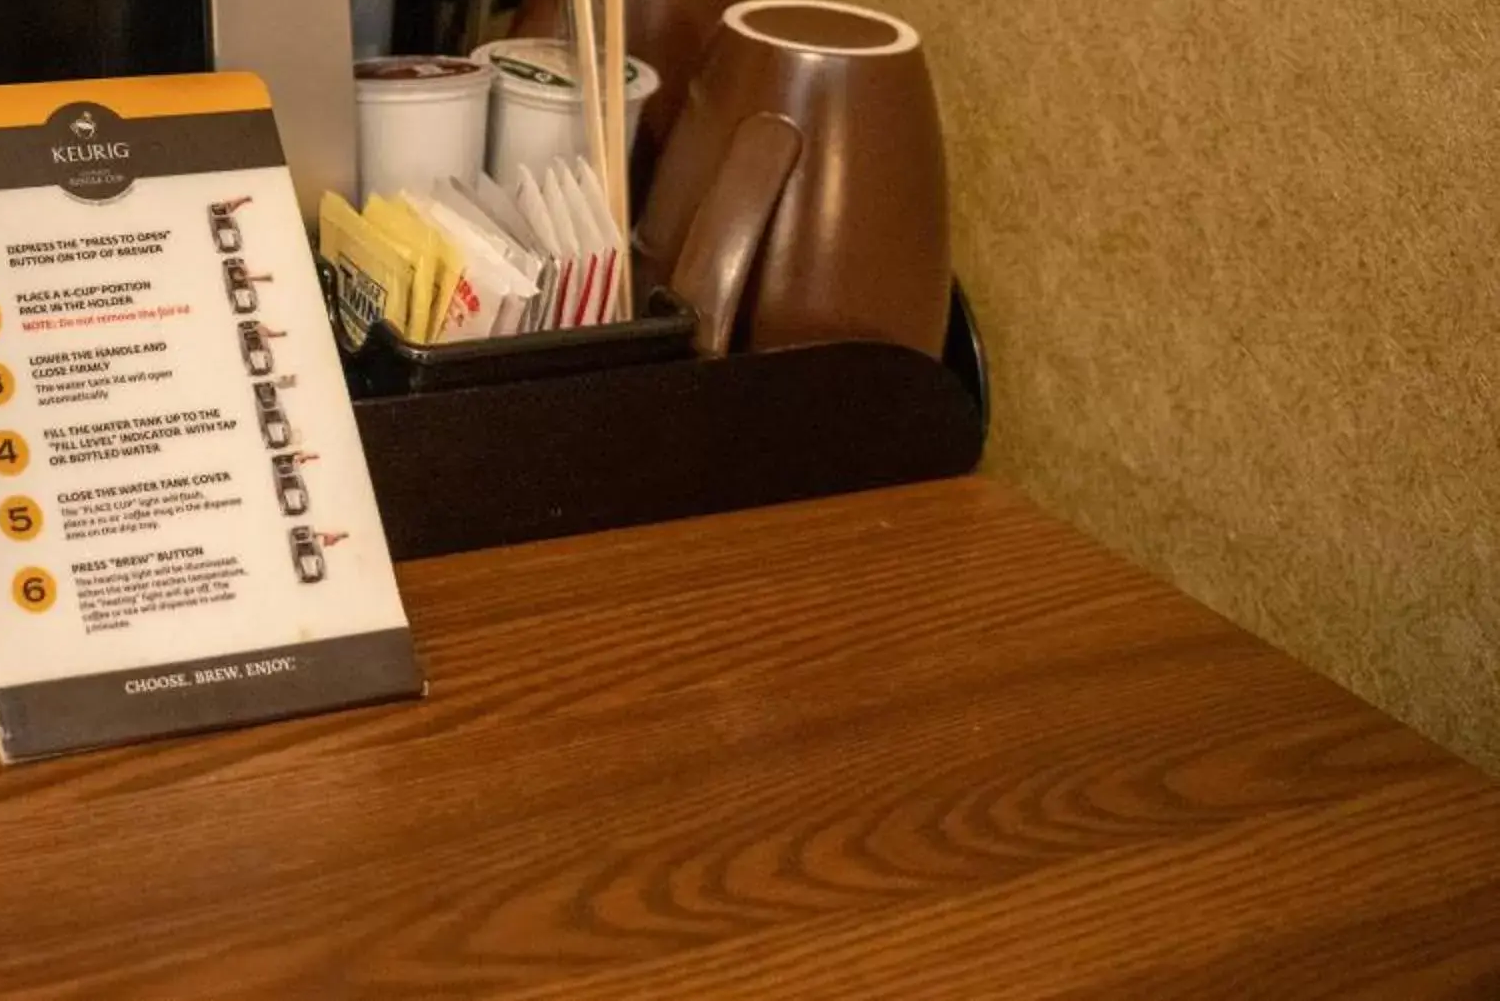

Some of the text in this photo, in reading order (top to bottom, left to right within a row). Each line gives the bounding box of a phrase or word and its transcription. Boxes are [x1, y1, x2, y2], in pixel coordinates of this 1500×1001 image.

[51, 142, 130, 163] KEURIG
[7, 241, 55, 255] DEPRESS
[57, 239, 77, 250] THE
[121, 234, 134, 244] TO
[9, 244, 162, 267] BUTTON ON TOP OF BREWER
[17, 291, 50, 303] PLACE
[53, 290, 60, 300] A
[102, 281, 151, 295] PORTION
[20, 296, 133, 315] PACK IN THE HOLDER
[76, 315, 94, 325] not
[97, 311, 136, 323] remove
[139, 309, 155, 319] the
[30, 342, 166, 366] LOWER THE HANDLE AND
[32, 362, 110, 379] CLOSE FIRMLY
[36, 382, 54, 393] The
[56, 379, 86, 391] water
[88, 376, 110, 387] tank
[148, 370, 172, 385] open
[44, 409, 220, 439] FILL THE WATER TANK UP TO THE
[120, 427, 181, 444] INDICATOR
[186, 423, 214, 436] WITH
[217, 421, 237, 432] TAP
[50, 443, 161, 466] OR BOTTLED WATER
[57, 472, 231, 504] CLOSE THE WATER TANK COVER
[7, 506, 33, 534] 5
[72, 547, 204, 573] PRESS "BREW" BUTTON
[22, 577, 46, 603] 6
[125, 673, 191, 695] CHOOSE.
[195, 665, 243, 686] BREW.
